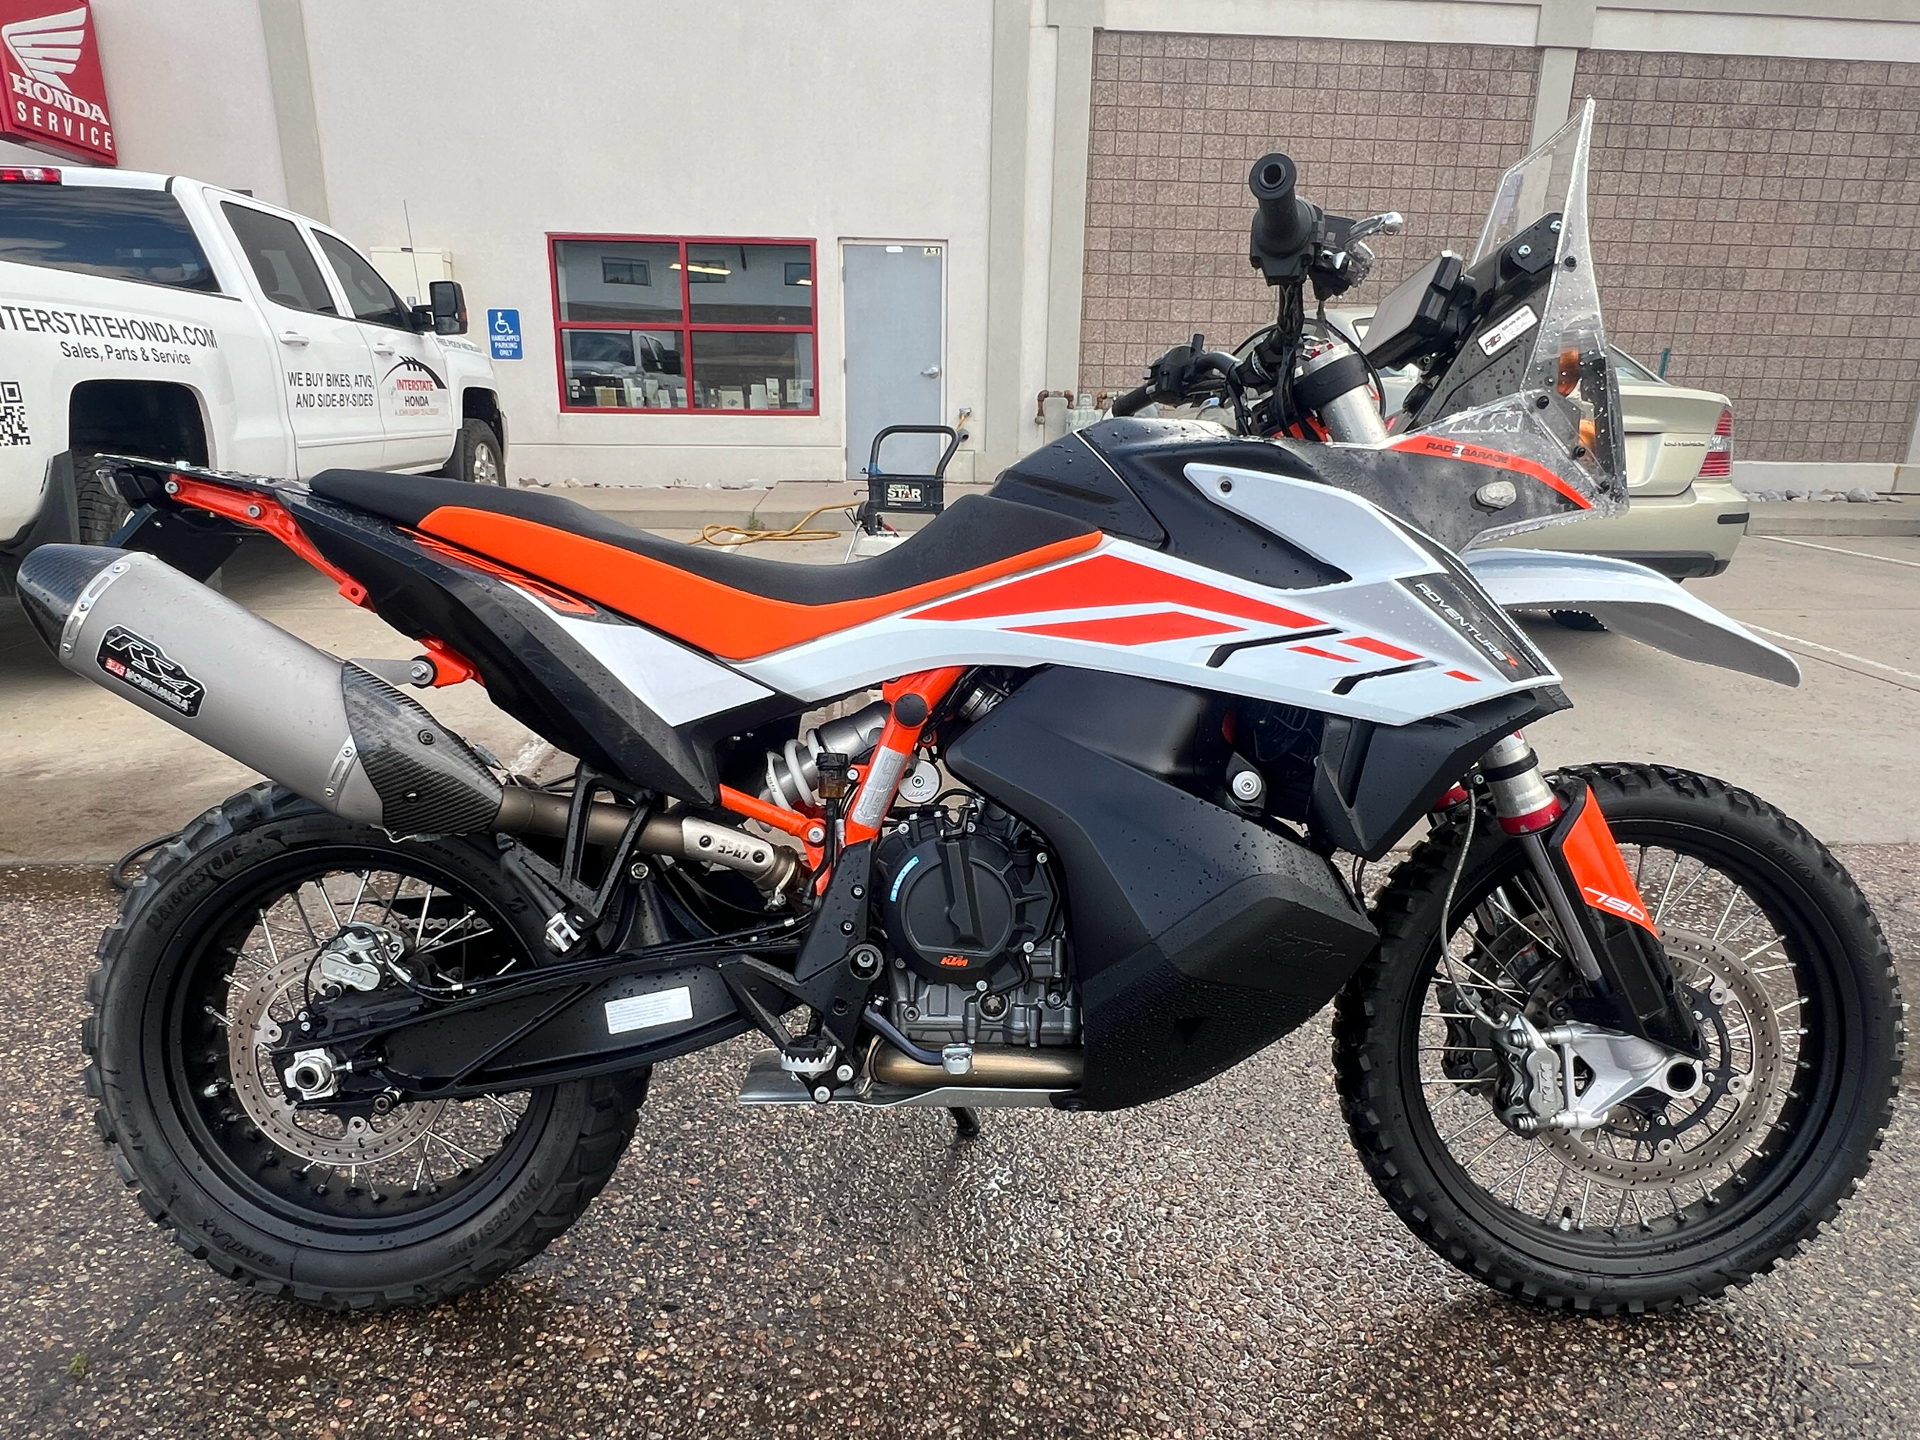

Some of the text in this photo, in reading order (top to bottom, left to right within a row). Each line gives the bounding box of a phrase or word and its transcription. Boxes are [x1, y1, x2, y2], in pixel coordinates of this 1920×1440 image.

[9, 71, 110, 126] HONDA
[16, 100, 113, 151] SERVICE
[0, 305, 218, 348] TERSTATEHONDA.COM
[60, 341, 191, 364] Sales, Parts & Service
[287, 372, 375, 390] WE BUY BIKES, ATVS,
[396, 379, 433, 391] INTERSTATE
[295, 393, 374, 408] AND SIDE-BY-SIDES
[404, 396, 429, 407] HONDA
[1425, 442, 1509, 463] RADE GARAGE
[887, 488, 921, 499] STAR
[1415, 582, 1508, 662] ADVENTURE
[124, 667, 189, 712] YOSHIMURA
[1583, 886, 1645, 921] 790
[940, 955, 969, 967] KTM
